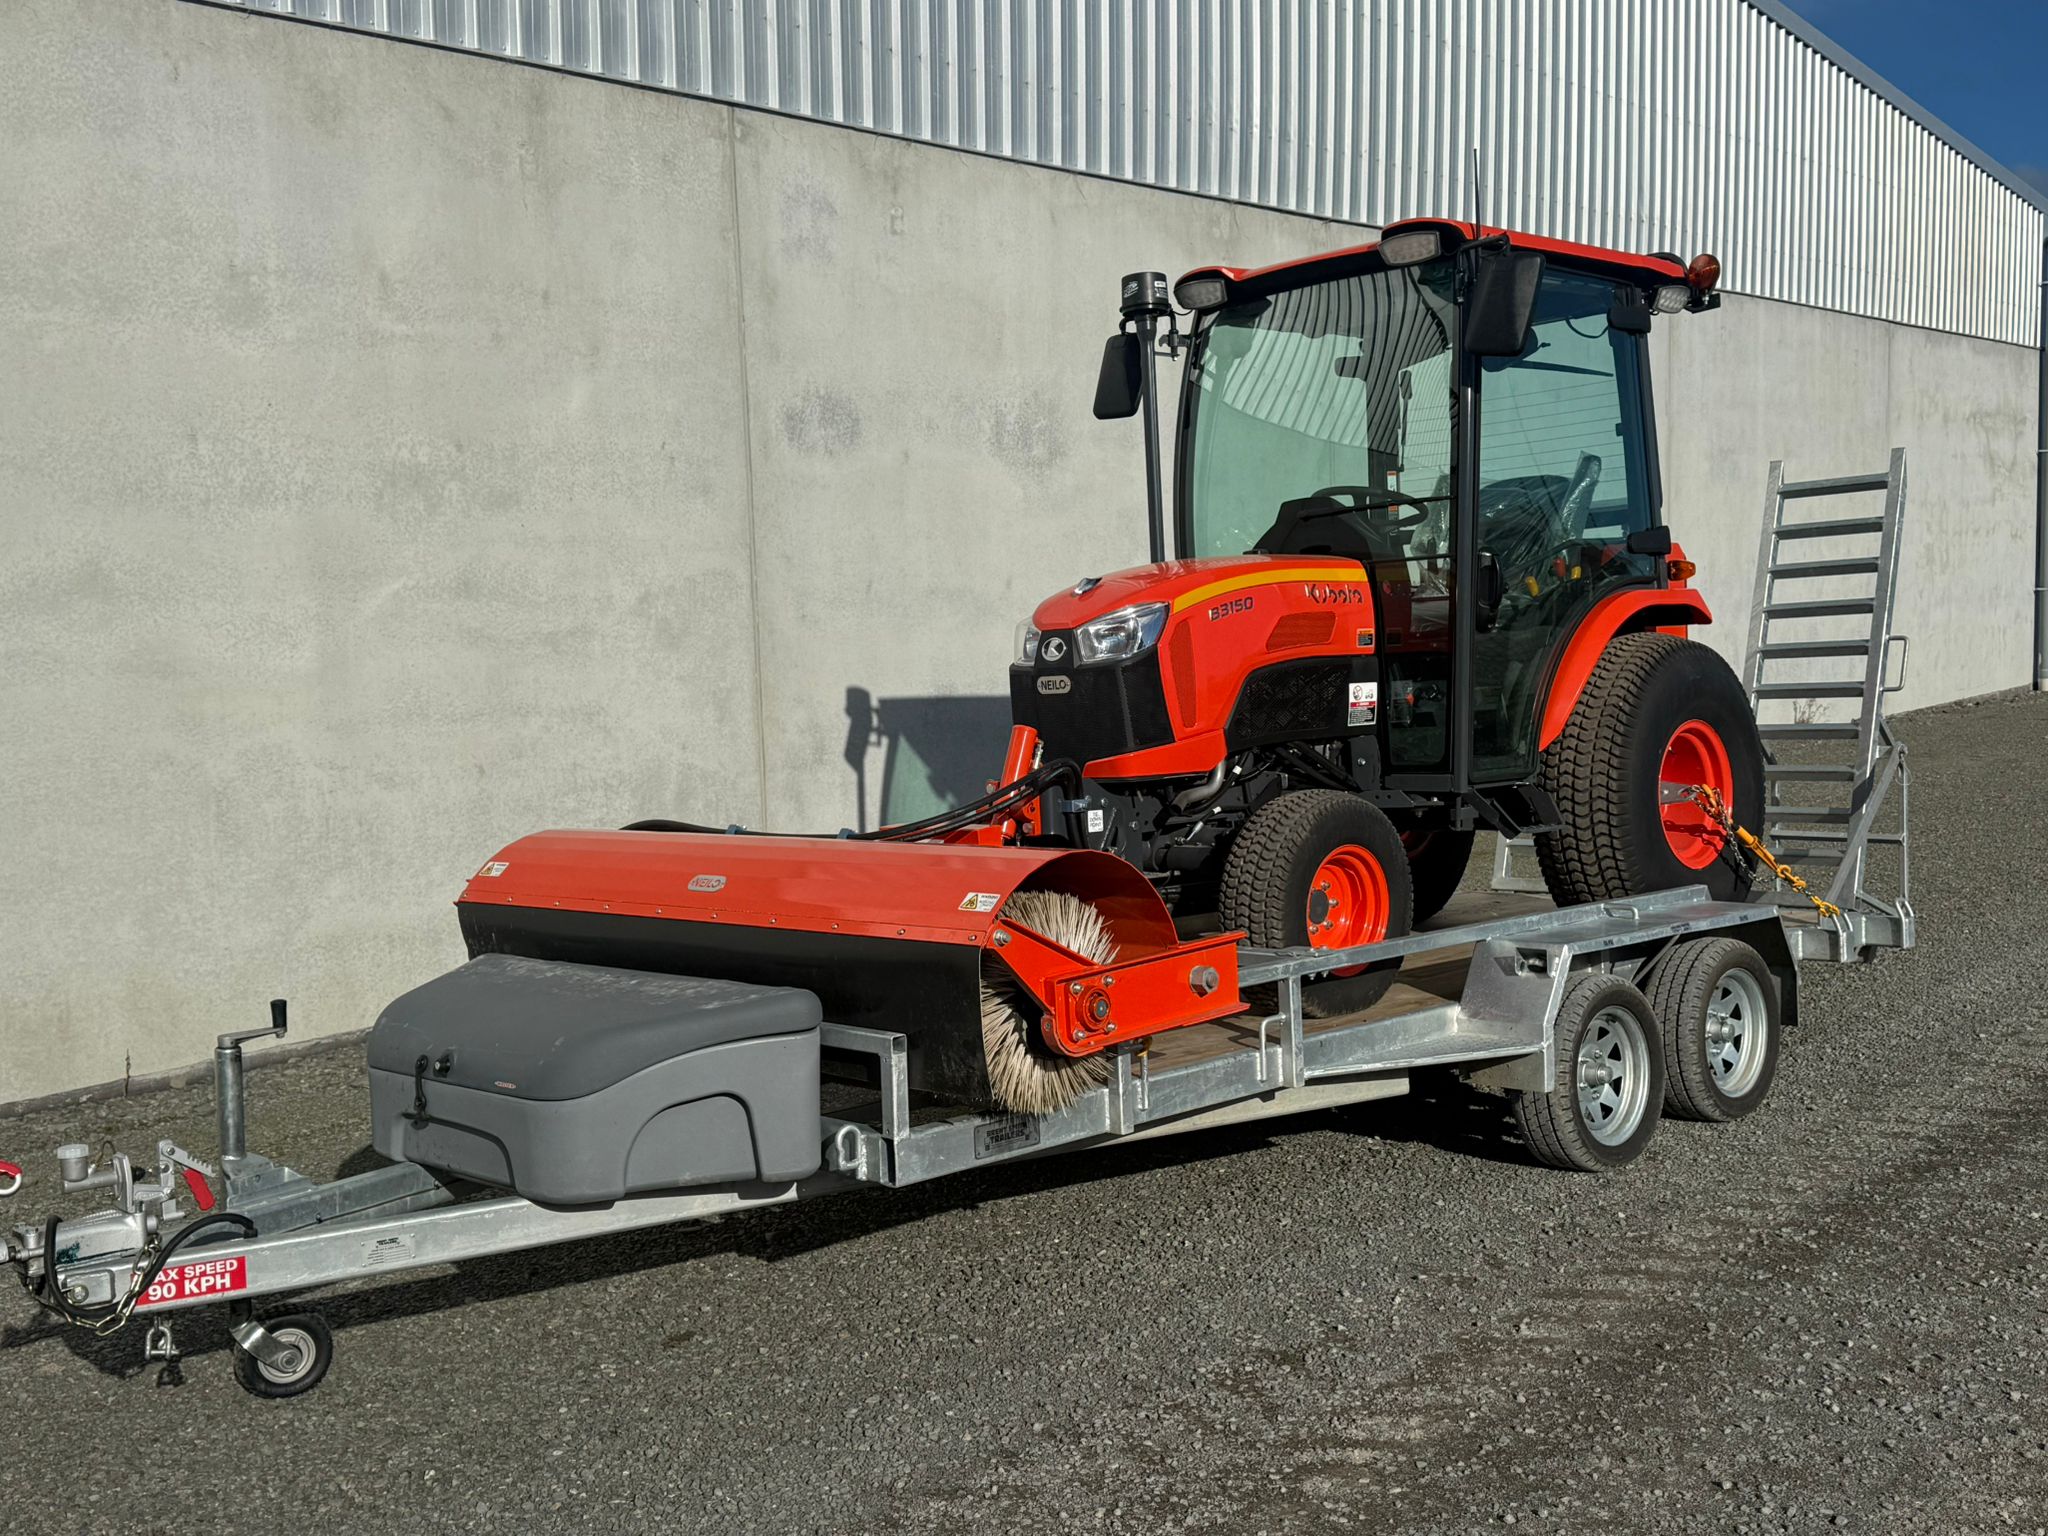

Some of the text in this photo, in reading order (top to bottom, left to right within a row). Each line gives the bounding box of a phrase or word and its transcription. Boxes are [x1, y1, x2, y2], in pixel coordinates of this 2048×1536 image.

[1304, 583, 1363, 604] Kubota
[1208, 596, 1254, 621] B3150
[1040, 679, 1067, 691] NEILO
[693, 877, 721, 889] NEILO
[153, 1259, 238, 1284] AX SPEED
[147, 1272, 231, 1301] 90 KPH
